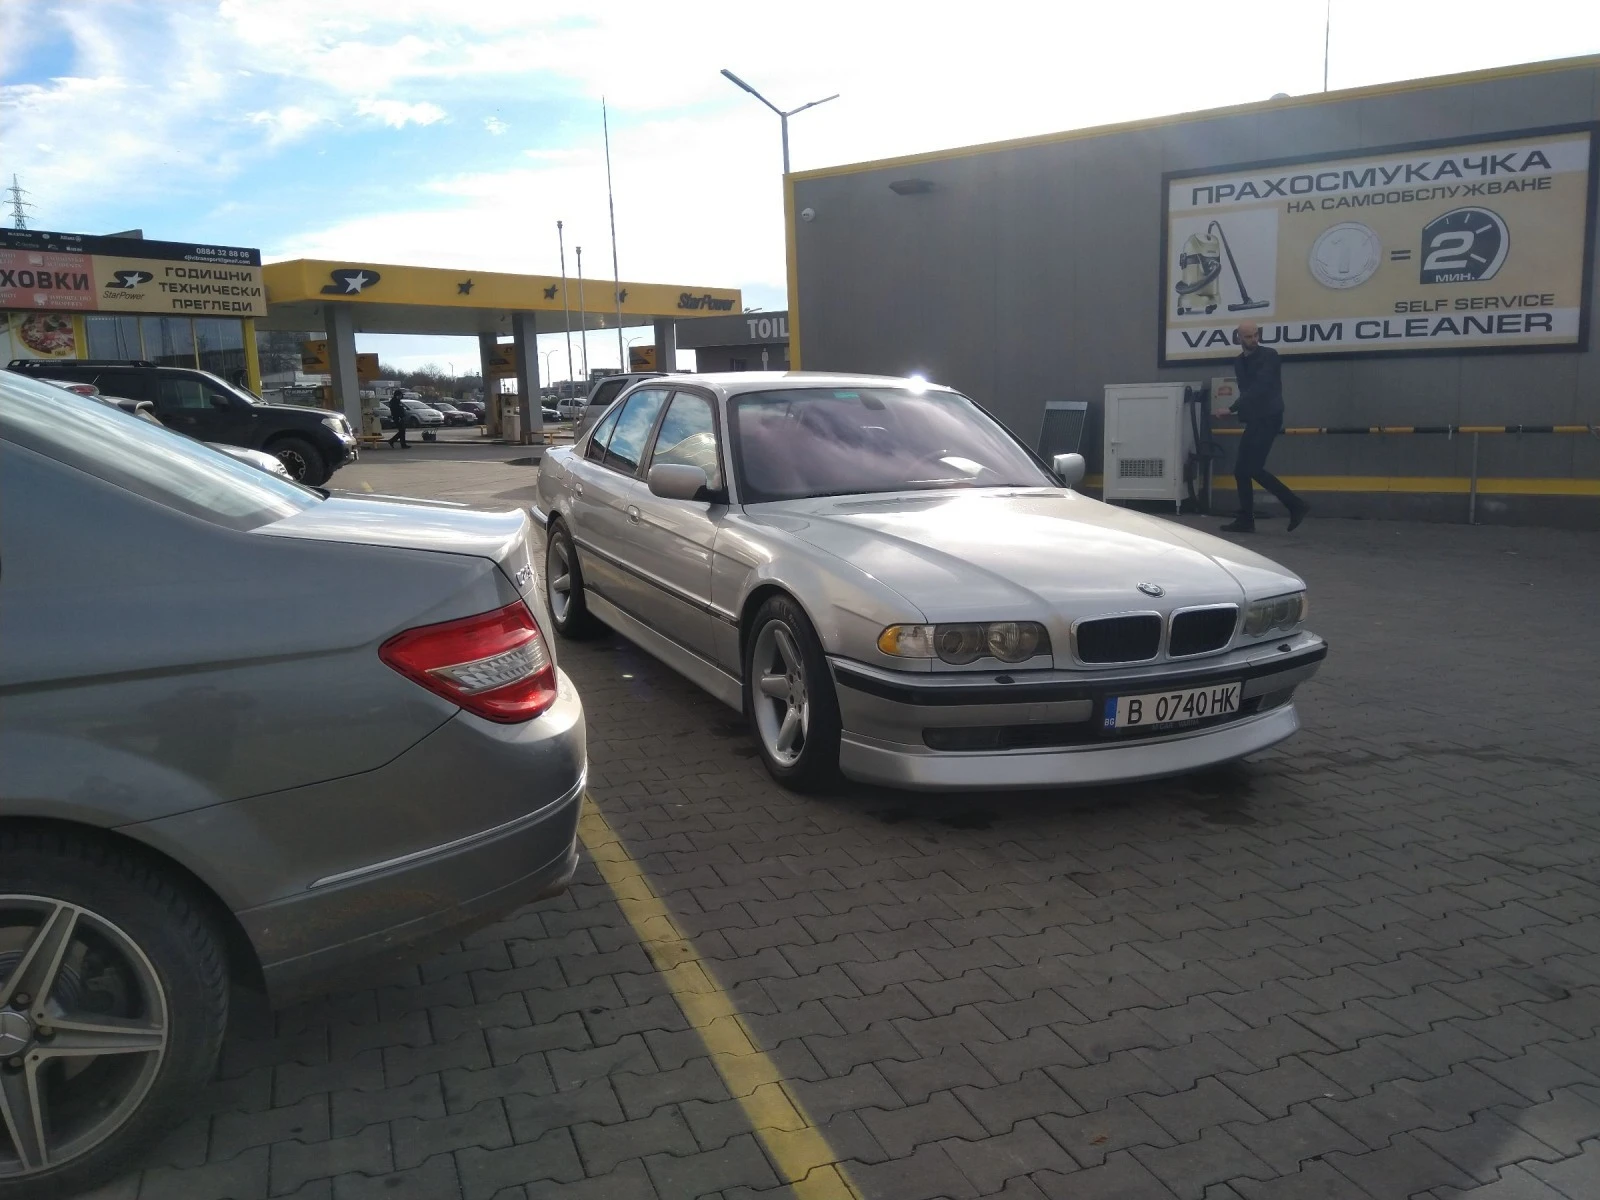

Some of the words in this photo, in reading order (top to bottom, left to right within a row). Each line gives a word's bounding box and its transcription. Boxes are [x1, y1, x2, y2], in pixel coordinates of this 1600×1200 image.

[1192, 151, 1552, 206] ПРАХОСМУКАЧКА
[1287, 201, 1316, 214] НА
[1321, 177, 1552, 210] САМООБСЛУЖВАНЕ
[196, 247, 216, 256] 0884
[240, 251, 250, 259] 06
[1424, 230, 1475, 271] 2
[0, 269, 89, 291] ХОВКИ
[165, 266, 252, 282] ГОДИШНИ
[1435, 273, 1475, 282] МИН.
[103, 291, 145, 300] StarPower
[159, 282, 261, 297] ТЕХНИЧЕСКИ
[172, 298, 253, 312] ПРЕГЛЕДИ
[677, 292, 736, 311] StarPower
[1394, 299, 1448, 313] SELF
[1454, 294, 1555, 310] SERVICE
[1355, 313, 1553, 339] CLEANER
[1128, 699, 1143, 725] B
[1155, 692, 1207, 721] 0740
[1211, 686, 1237, 714] HK
[1104, 718, 1115, 726] BG
